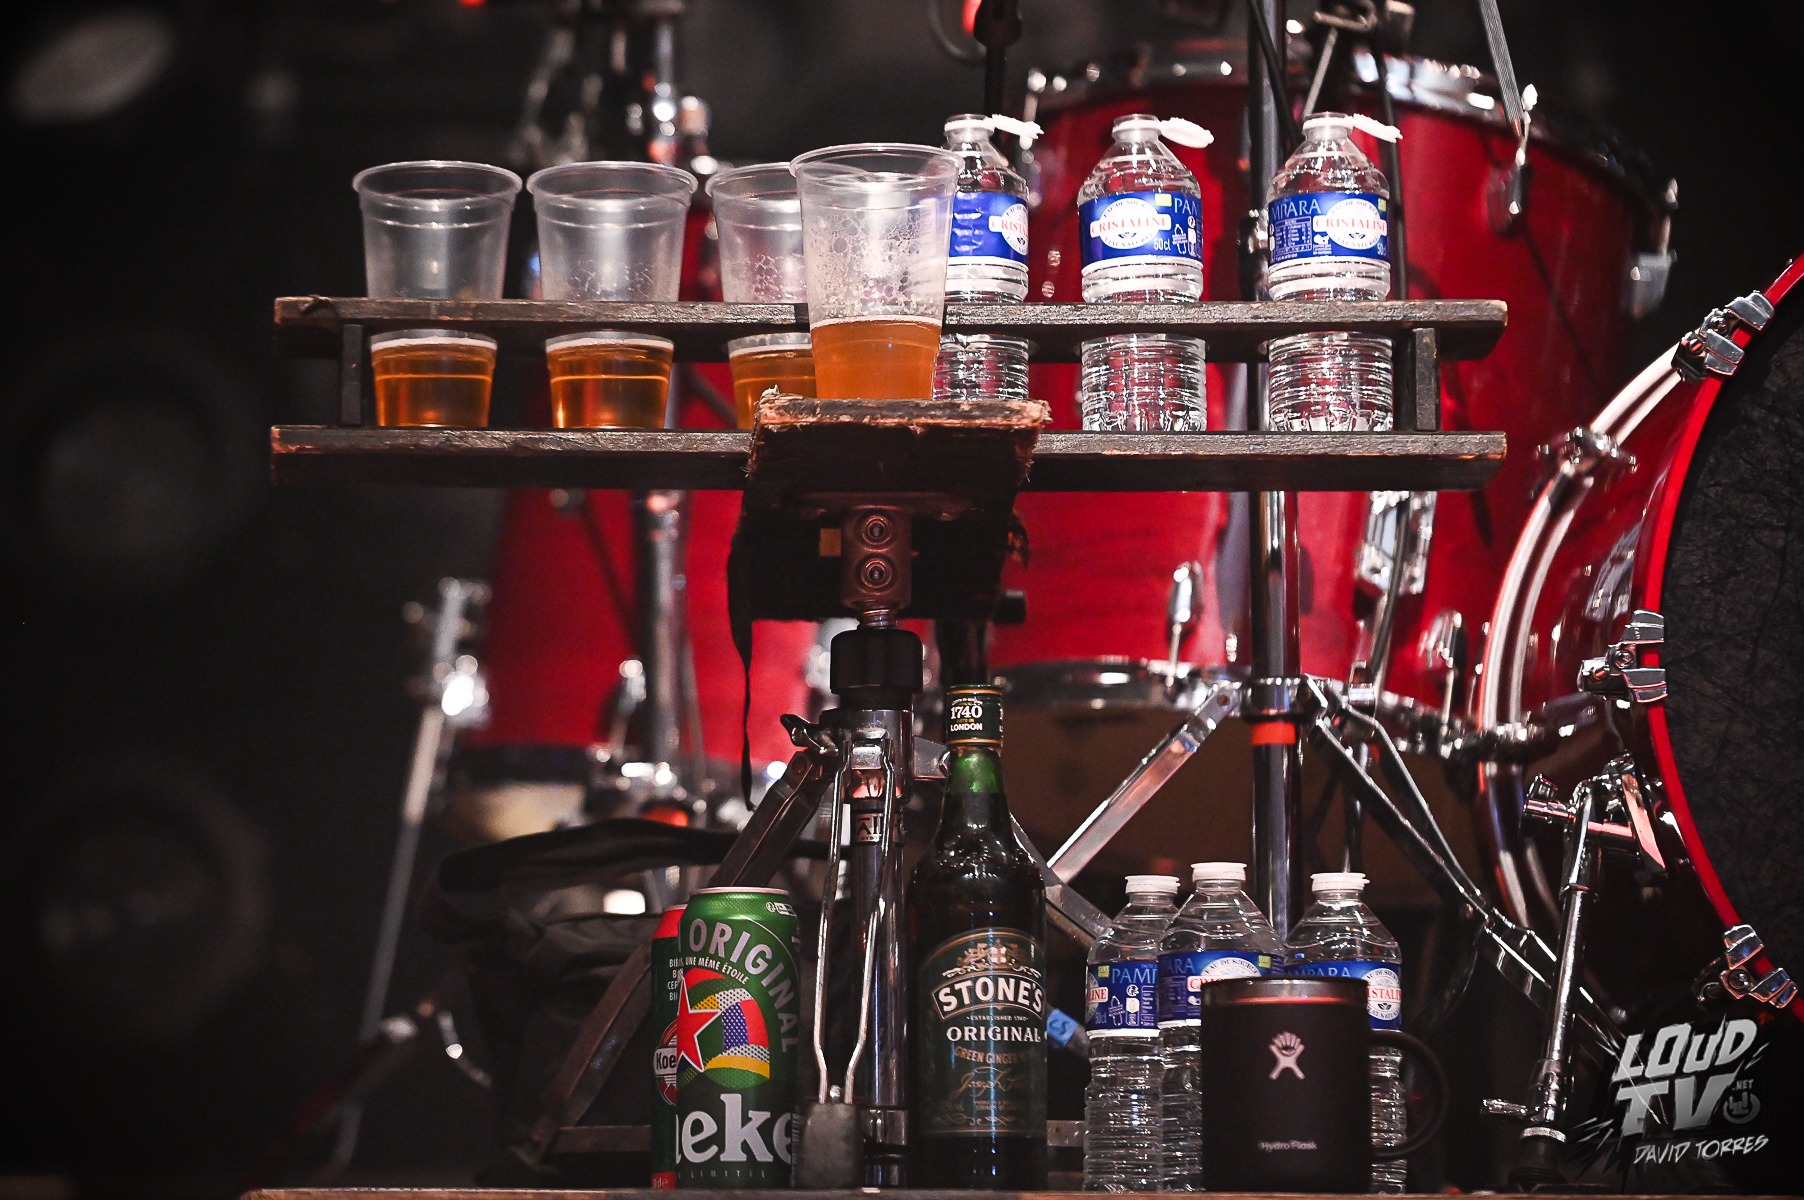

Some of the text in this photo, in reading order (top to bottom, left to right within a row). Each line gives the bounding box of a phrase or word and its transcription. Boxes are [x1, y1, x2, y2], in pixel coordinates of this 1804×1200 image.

[950, 705, 983, 720] 1740
[950, 722, 983, 732] LONDON
[698, 956, 721, 971] MÊME
[722, 963, 750, 985] ÉTOILE
[688, 918, 799, 1053] ORIGINAL
[938, 976, 1044, 1013] STONE'S
[946, 1025, 1042, 1043] ORIGINAL
[955, 1046, 984, 1063] GREEN
[1259, 1141, 1290, 1153] Hydro
